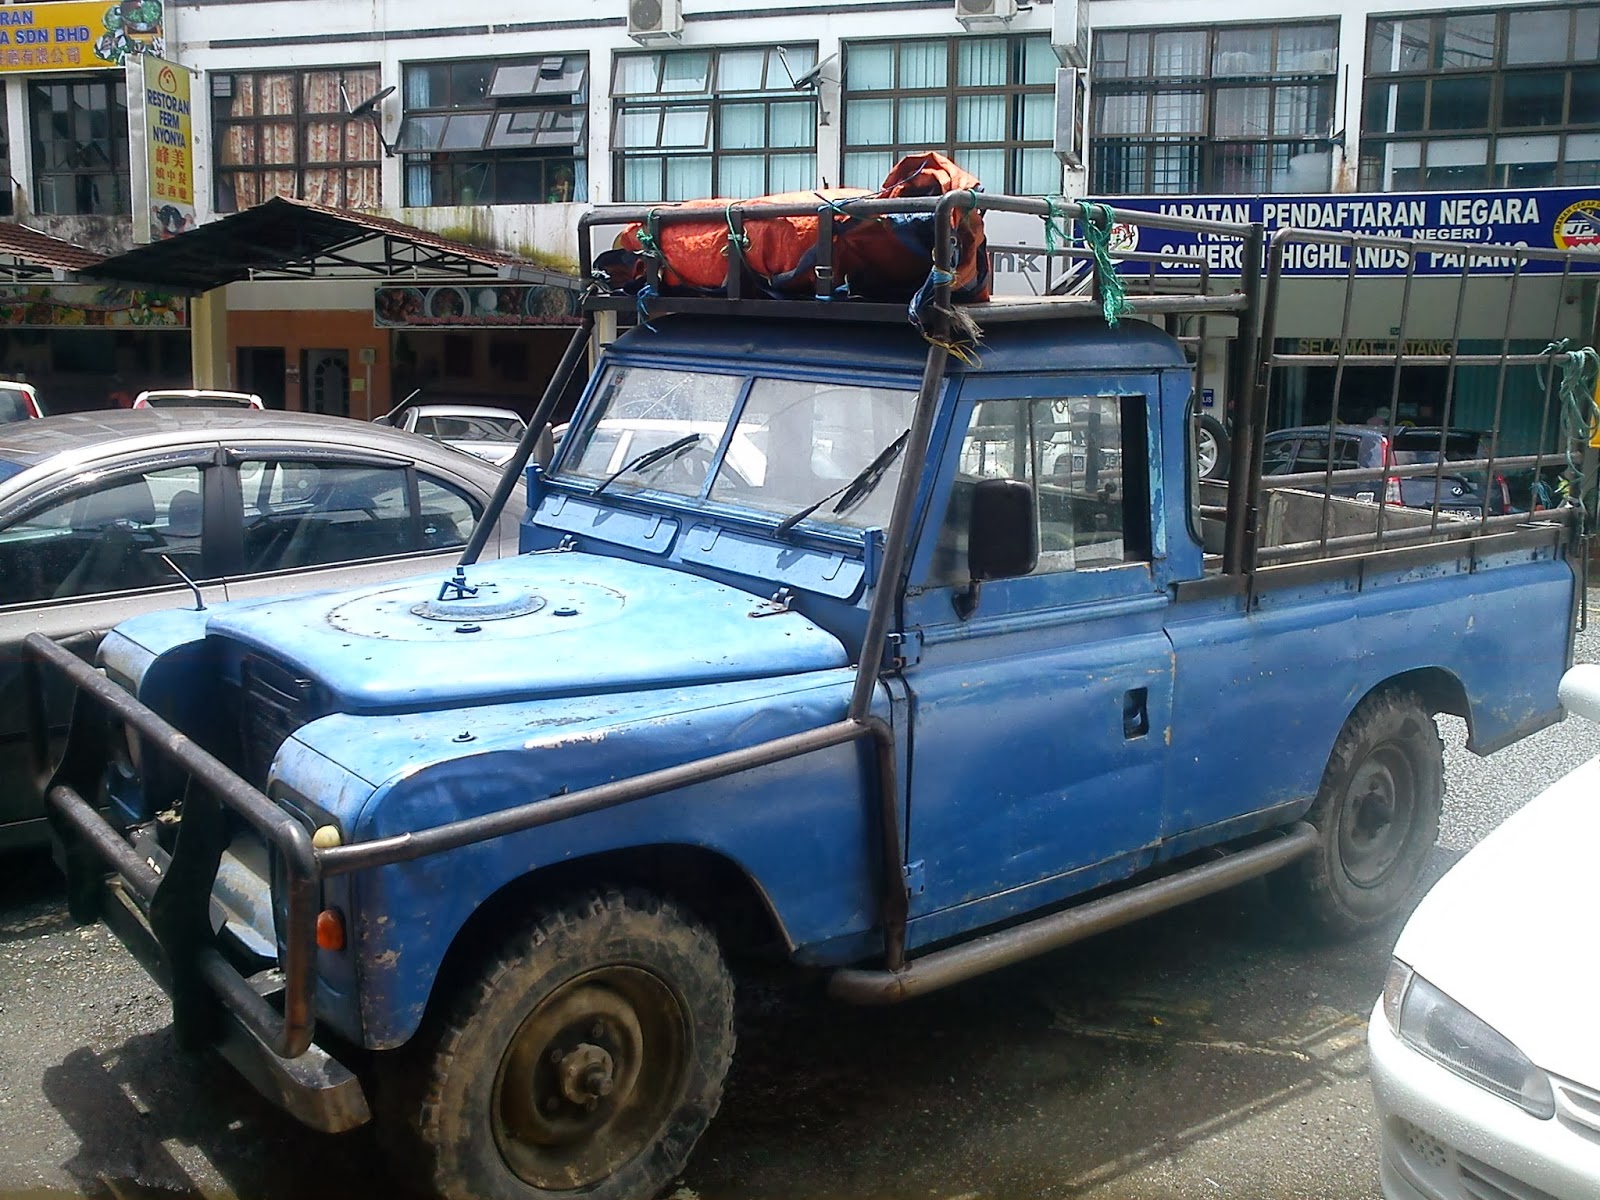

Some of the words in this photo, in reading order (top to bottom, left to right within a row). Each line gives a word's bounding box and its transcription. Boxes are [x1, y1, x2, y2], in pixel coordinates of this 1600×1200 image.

[0, 11, 33, 25] RAN
[16, 29, 48, 44] SDN
[55, 27, 89, 42] BHD
[147, 89, 190, 115] RESTORAN
[159, 110, 179, 129] FERM
[153, 126, 186, 149] NYONYA
[1263, 201, 1426, 228] PENDAFTARAN
[1440, 198, 1540, 225] NEGARA
[1413, 228, 1481, 240] NEGERI
[1566, 224, 1597, 235] JP
[1160, 244, 1265, 269] CAMERO
[1299, 338, 1375, 355] SELAMAT
